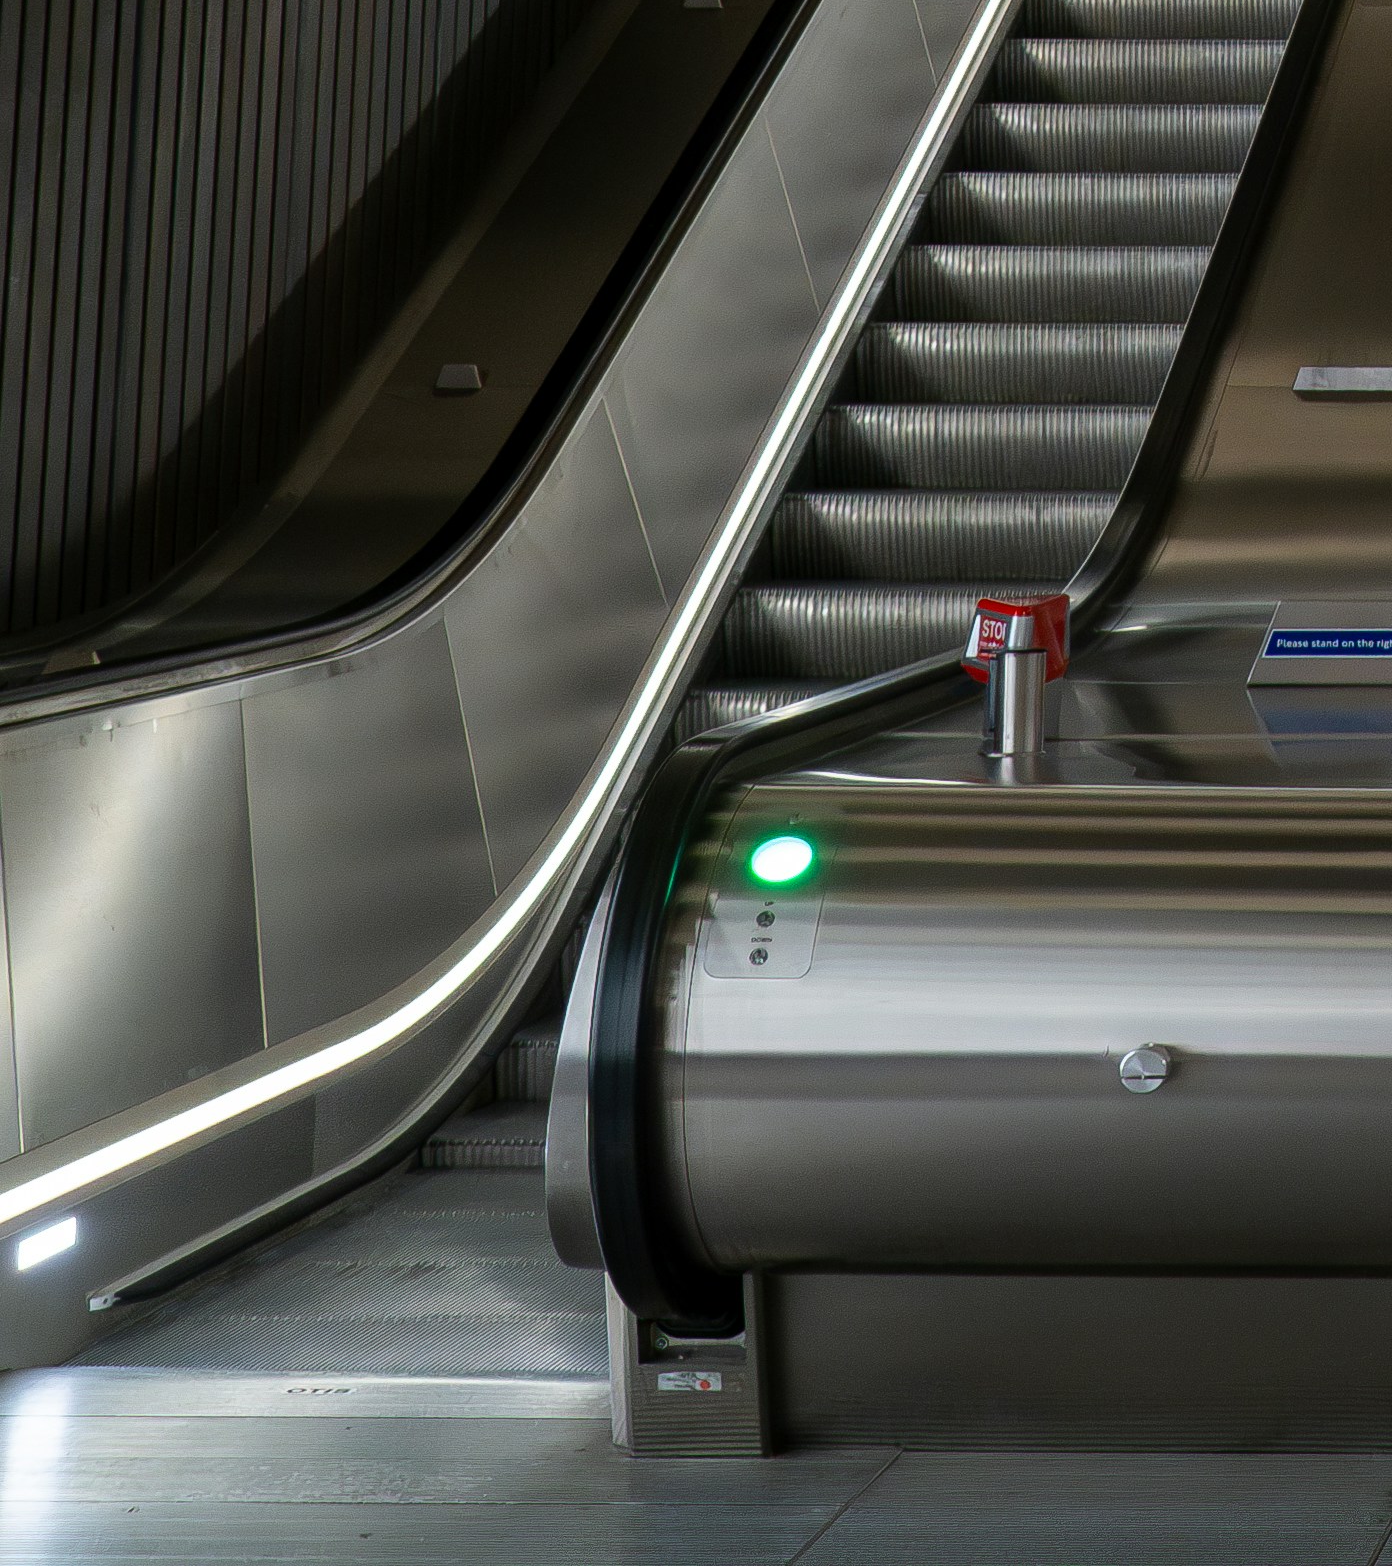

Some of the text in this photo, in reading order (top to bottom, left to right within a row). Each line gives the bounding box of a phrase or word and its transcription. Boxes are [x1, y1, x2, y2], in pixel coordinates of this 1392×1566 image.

[1276, 638, 1309, 648] Please
[1311, 638, 1339, 648] stand
[1341, 640, 1355, 648] on
[1357, 639, 1374, 648] the
